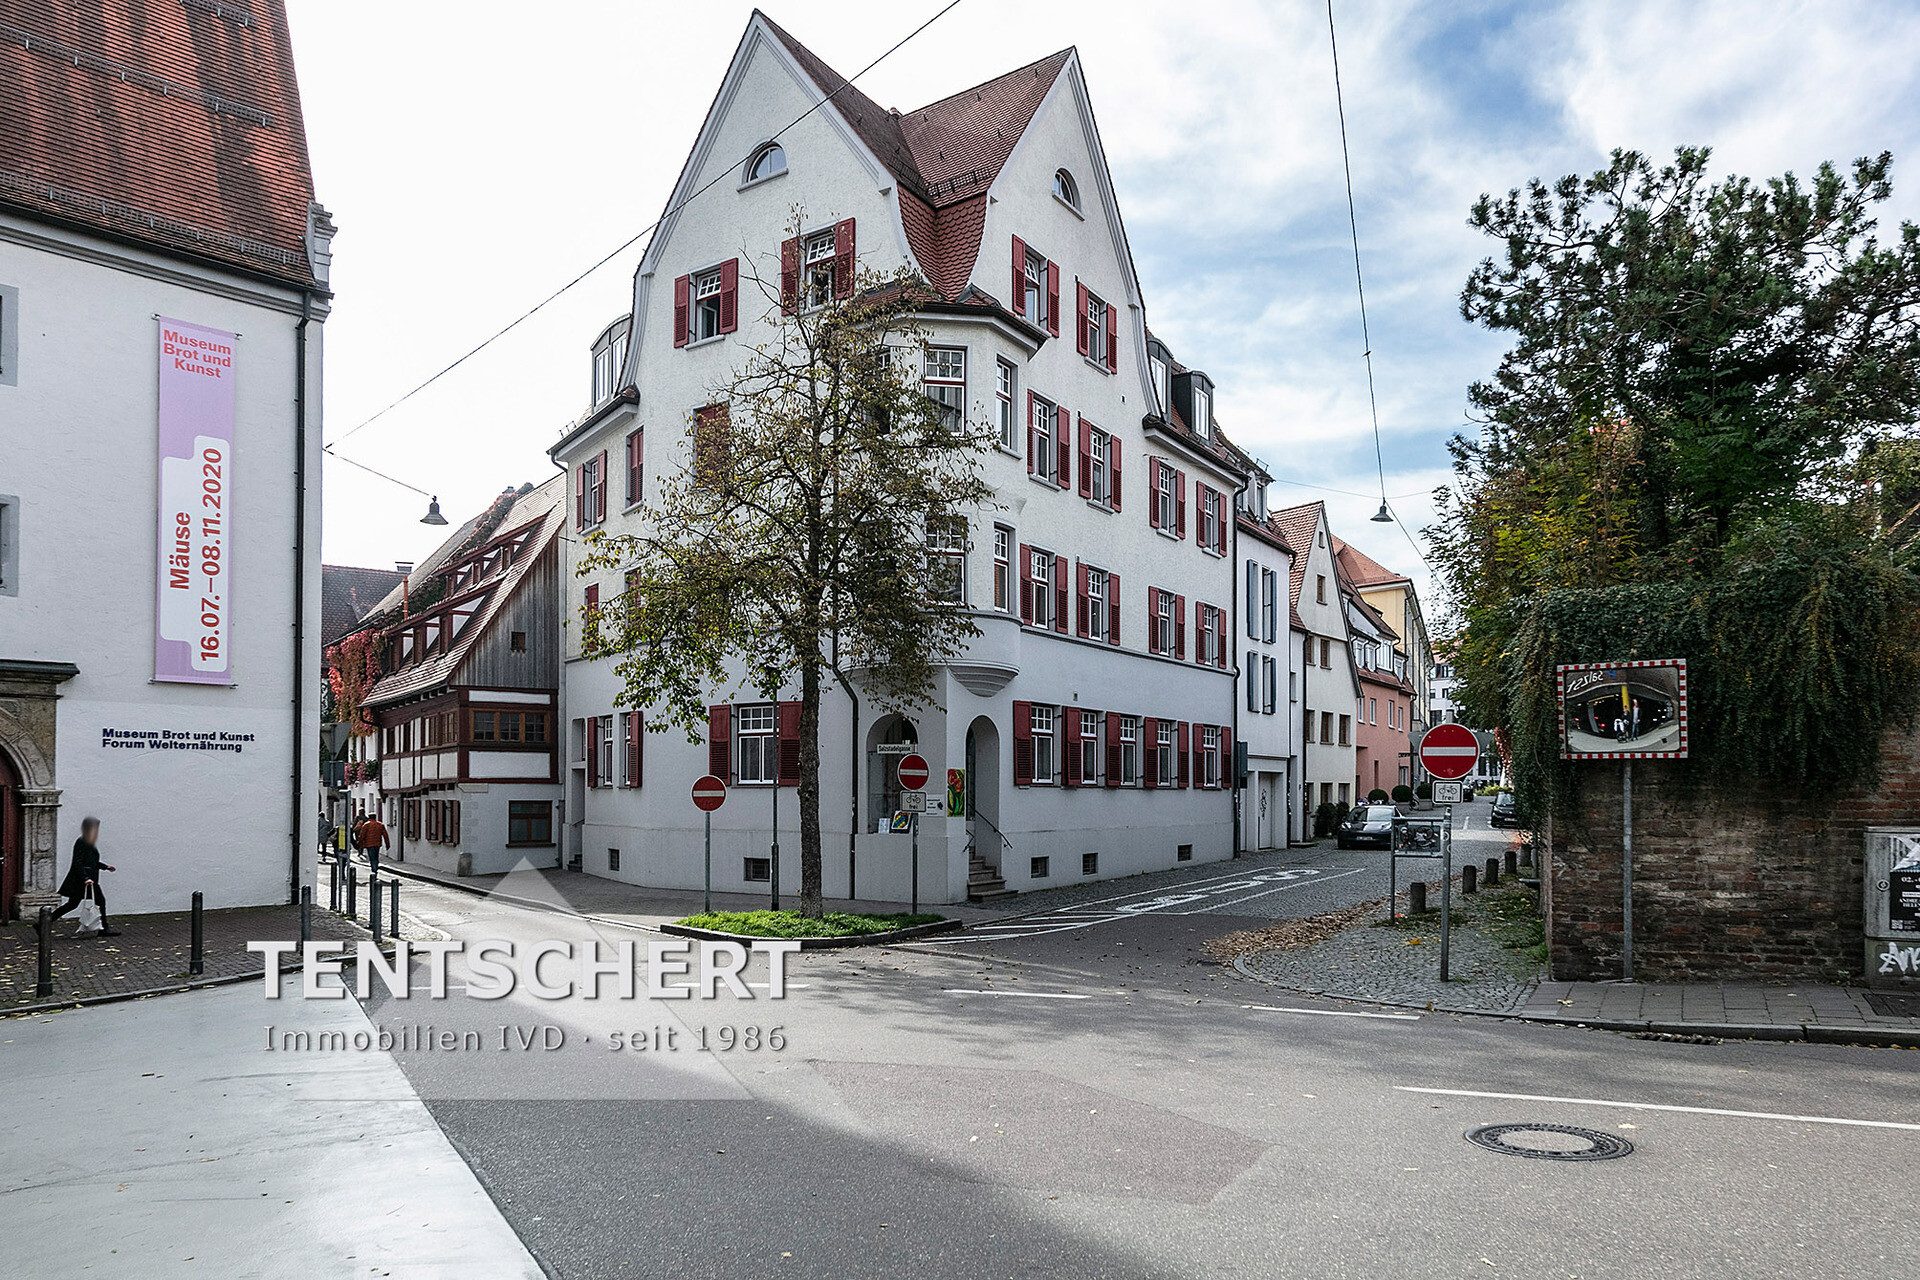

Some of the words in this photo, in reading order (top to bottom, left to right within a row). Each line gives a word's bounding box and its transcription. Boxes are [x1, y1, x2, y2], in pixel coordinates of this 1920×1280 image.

[163, 329, 231, 355] Museum
[163, 342, 199, 360] Brot
[202, 354, 231, 368] und
[175, 358, 221, 378] Kunst
[169, 511, 191, 590] Mäuse
[102, 728, 159, 739] Museum
[162, 730, 190, 740] Brot
[193, 732, 216, 741] und
[219, 732, 255, 742] Kunst
[102, 738, 145, 748] Forum
[149, 740, 242, 753] Welternährung
